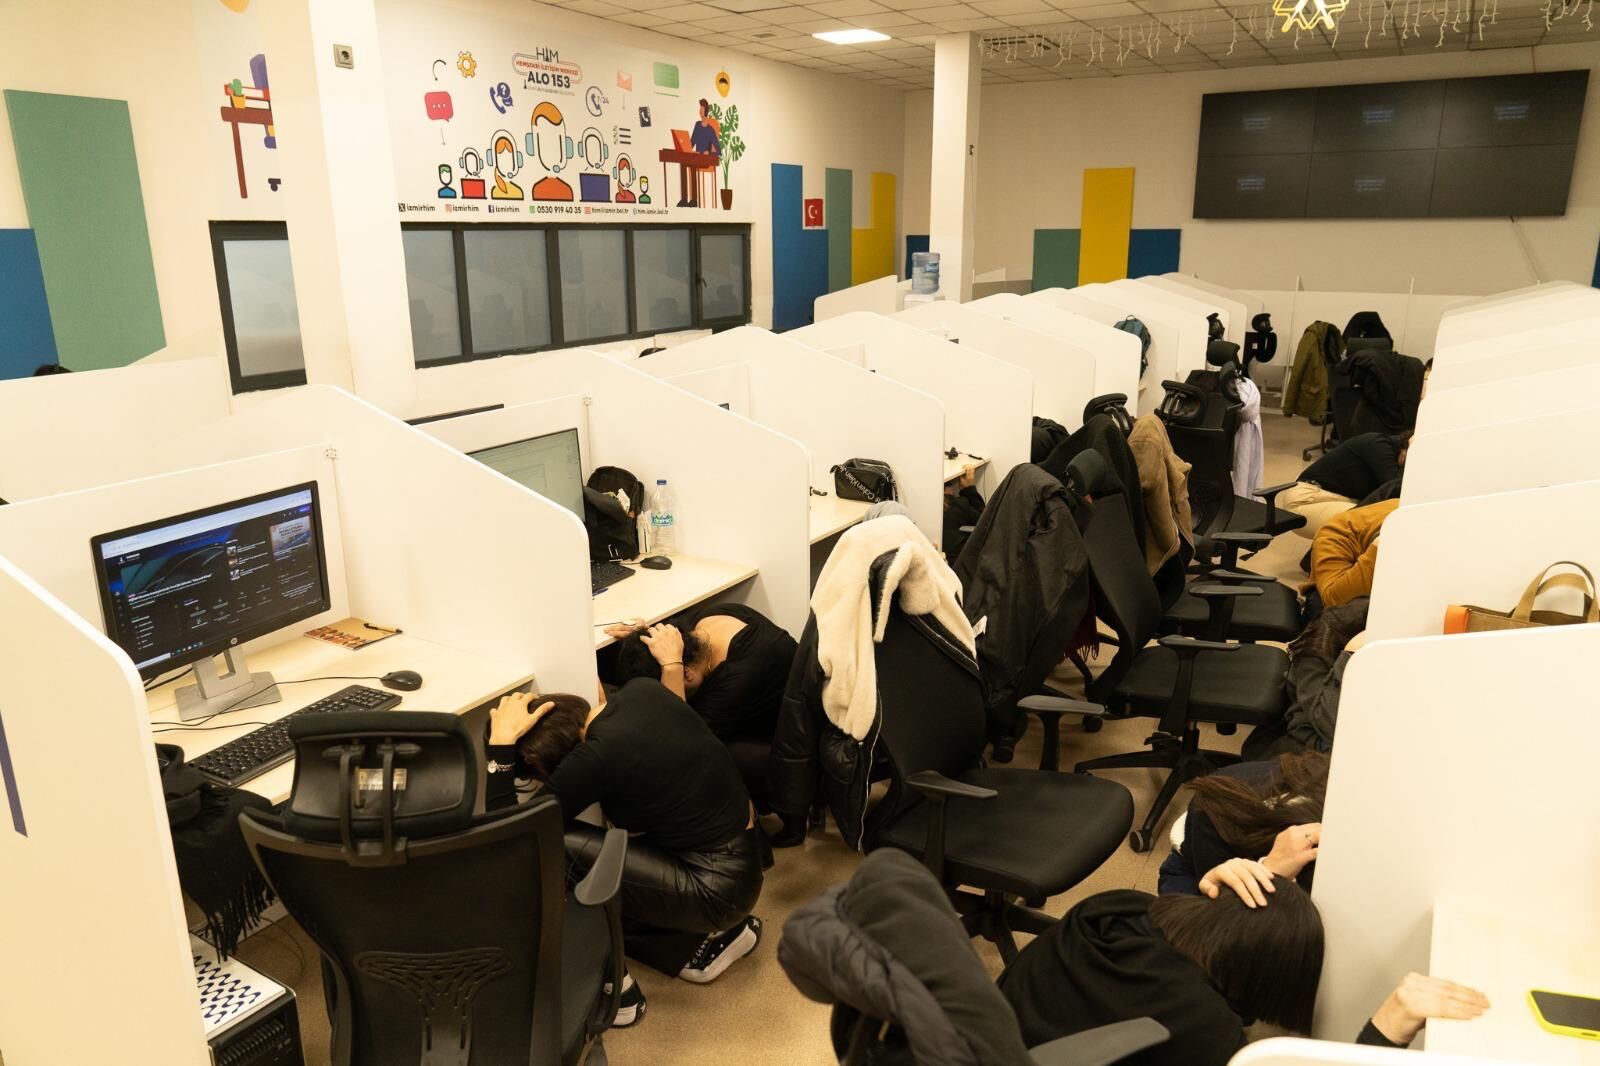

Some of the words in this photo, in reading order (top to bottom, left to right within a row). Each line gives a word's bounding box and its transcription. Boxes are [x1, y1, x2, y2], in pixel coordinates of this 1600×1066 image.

[527, 71, 550, 86] ALO
[551, 73, 571, 89] 153
[406, 203, 436, 212] izmirhim
[452, 204, 480, 213] izmirhim
[495, 205, 520, 213] izmirhim
[536, 205, 553, 214] 0530
[554, 206, 564, 214] 919
[565, 206, 574, 214] 40
[574, 206, 582, 214] 35
[856, 482, 876, 500] Calvin
